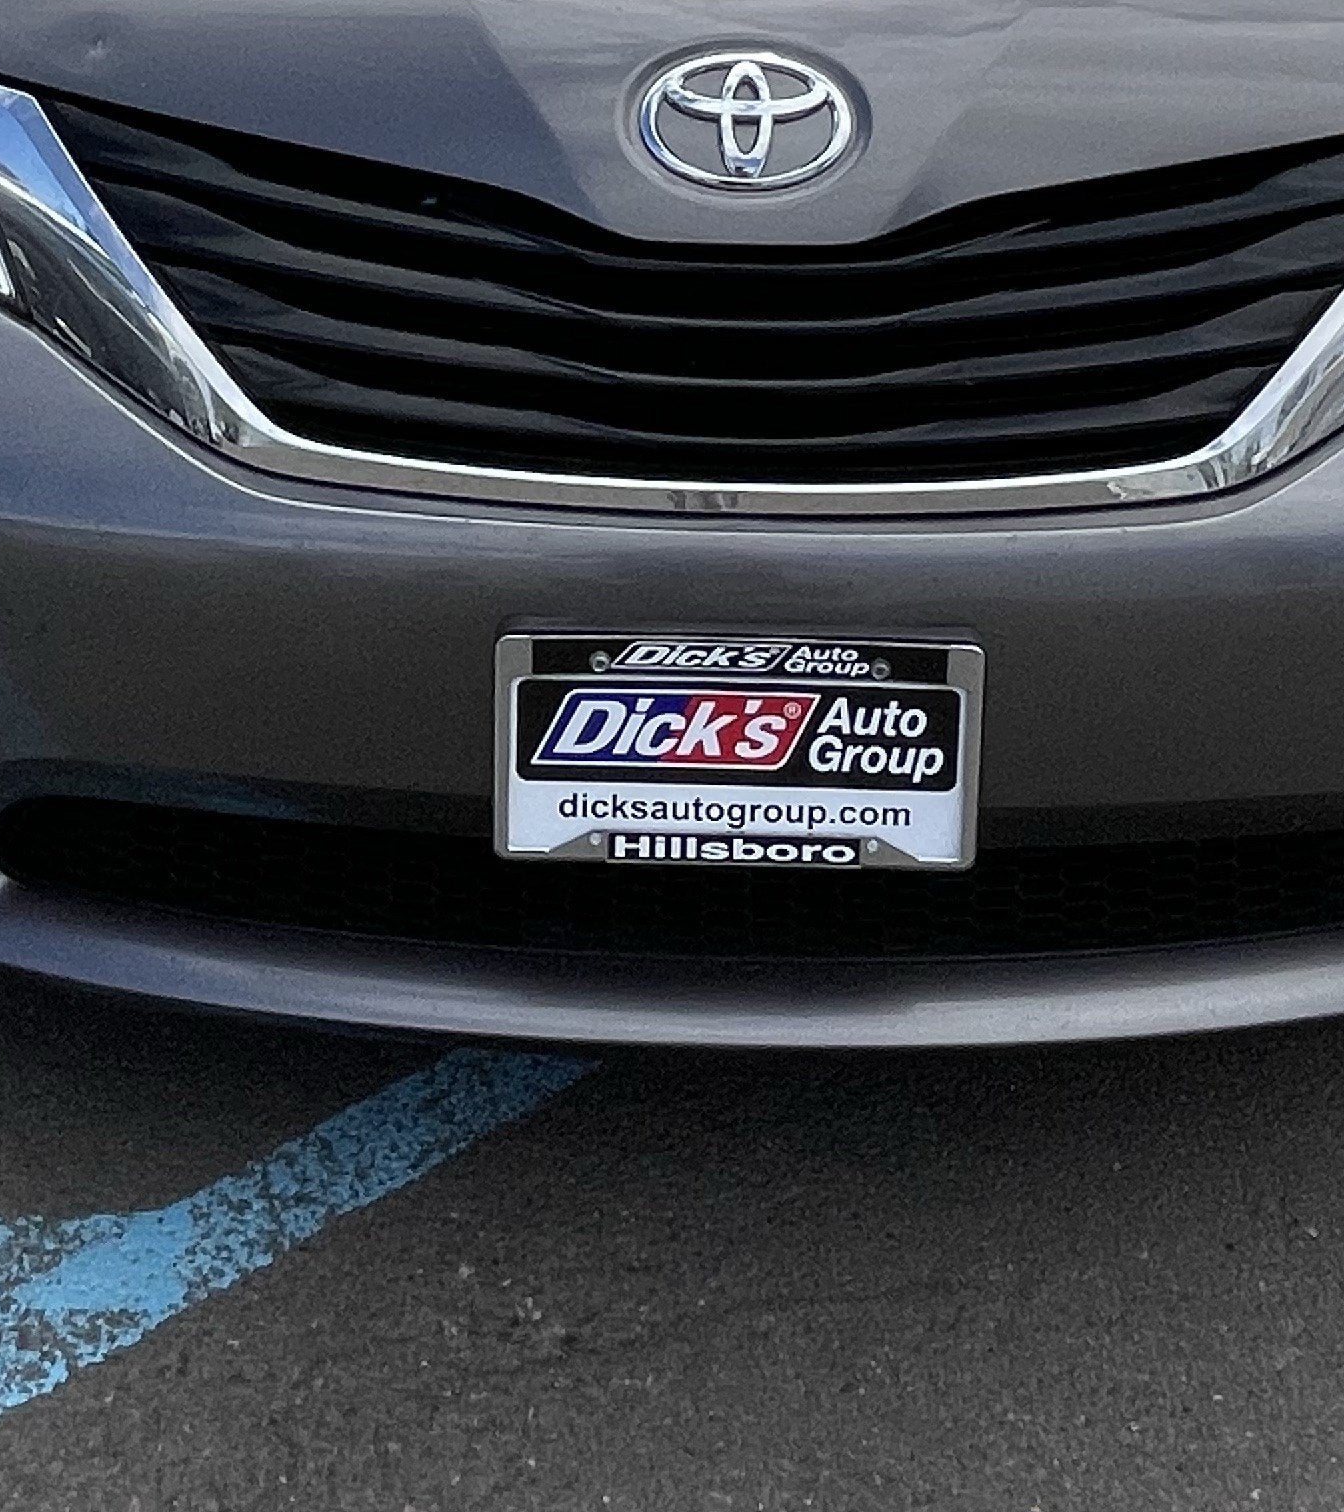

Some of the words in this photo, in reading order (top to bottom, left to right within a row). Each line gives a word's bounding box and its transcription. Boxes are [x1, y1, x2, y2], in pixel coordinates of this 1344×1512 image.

[784, 659, 870, 677] Group
[792, 646, 860, 661] Auto
[817, 697, 928, 738] Auto
[808, 738, 944, 783] Group
[558, 792, 913, 829] dicksautogroup.com
[613, 835, 856, 864] Hillsboro
